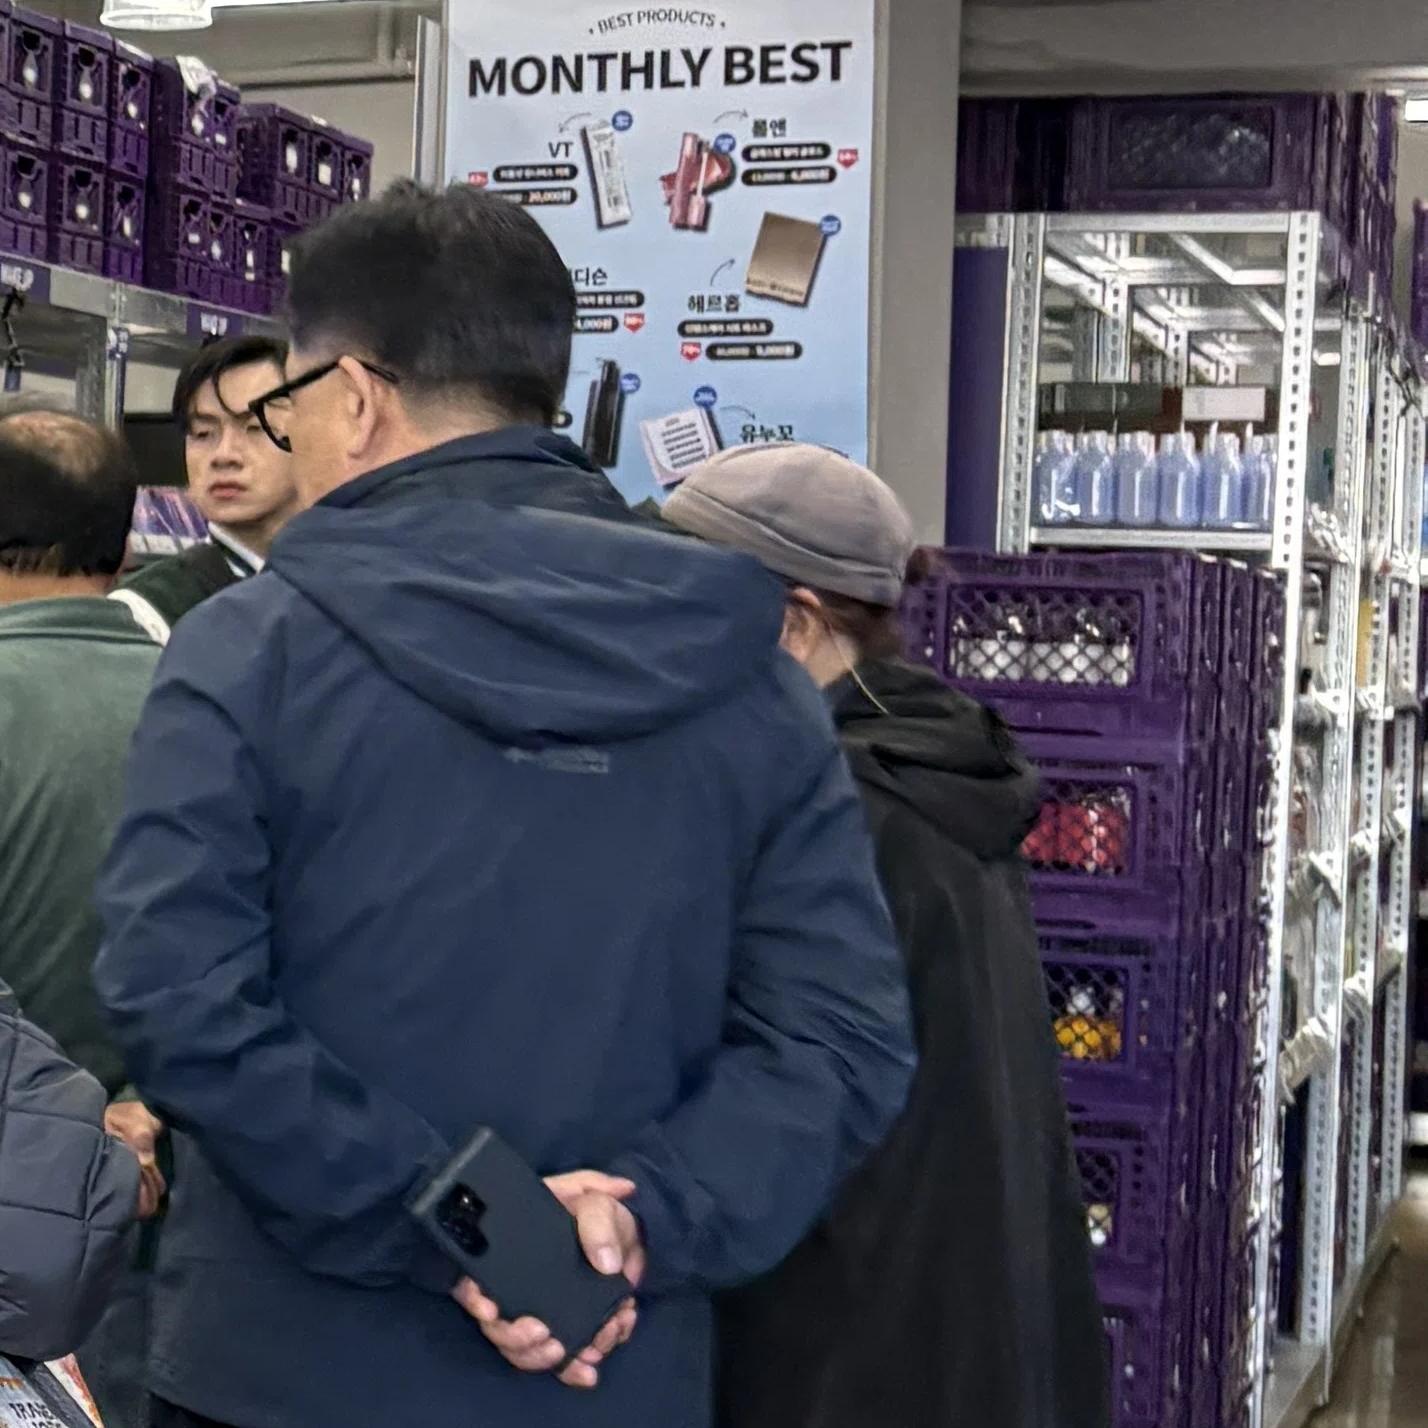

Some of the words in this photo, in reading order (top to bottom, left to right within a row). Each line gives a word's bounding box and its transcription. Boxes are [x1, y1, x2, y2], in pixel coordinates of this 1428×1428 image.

[598, 12, 633, 34] BEST
[637, 8, 716, 28] PRODUCTS
[468, 46, 713, 98] MONTHLY
[723, 40, 853, 87] BEST
[548, 141, 574, 159] VT
[569, 266, 608, 286] 디슨
